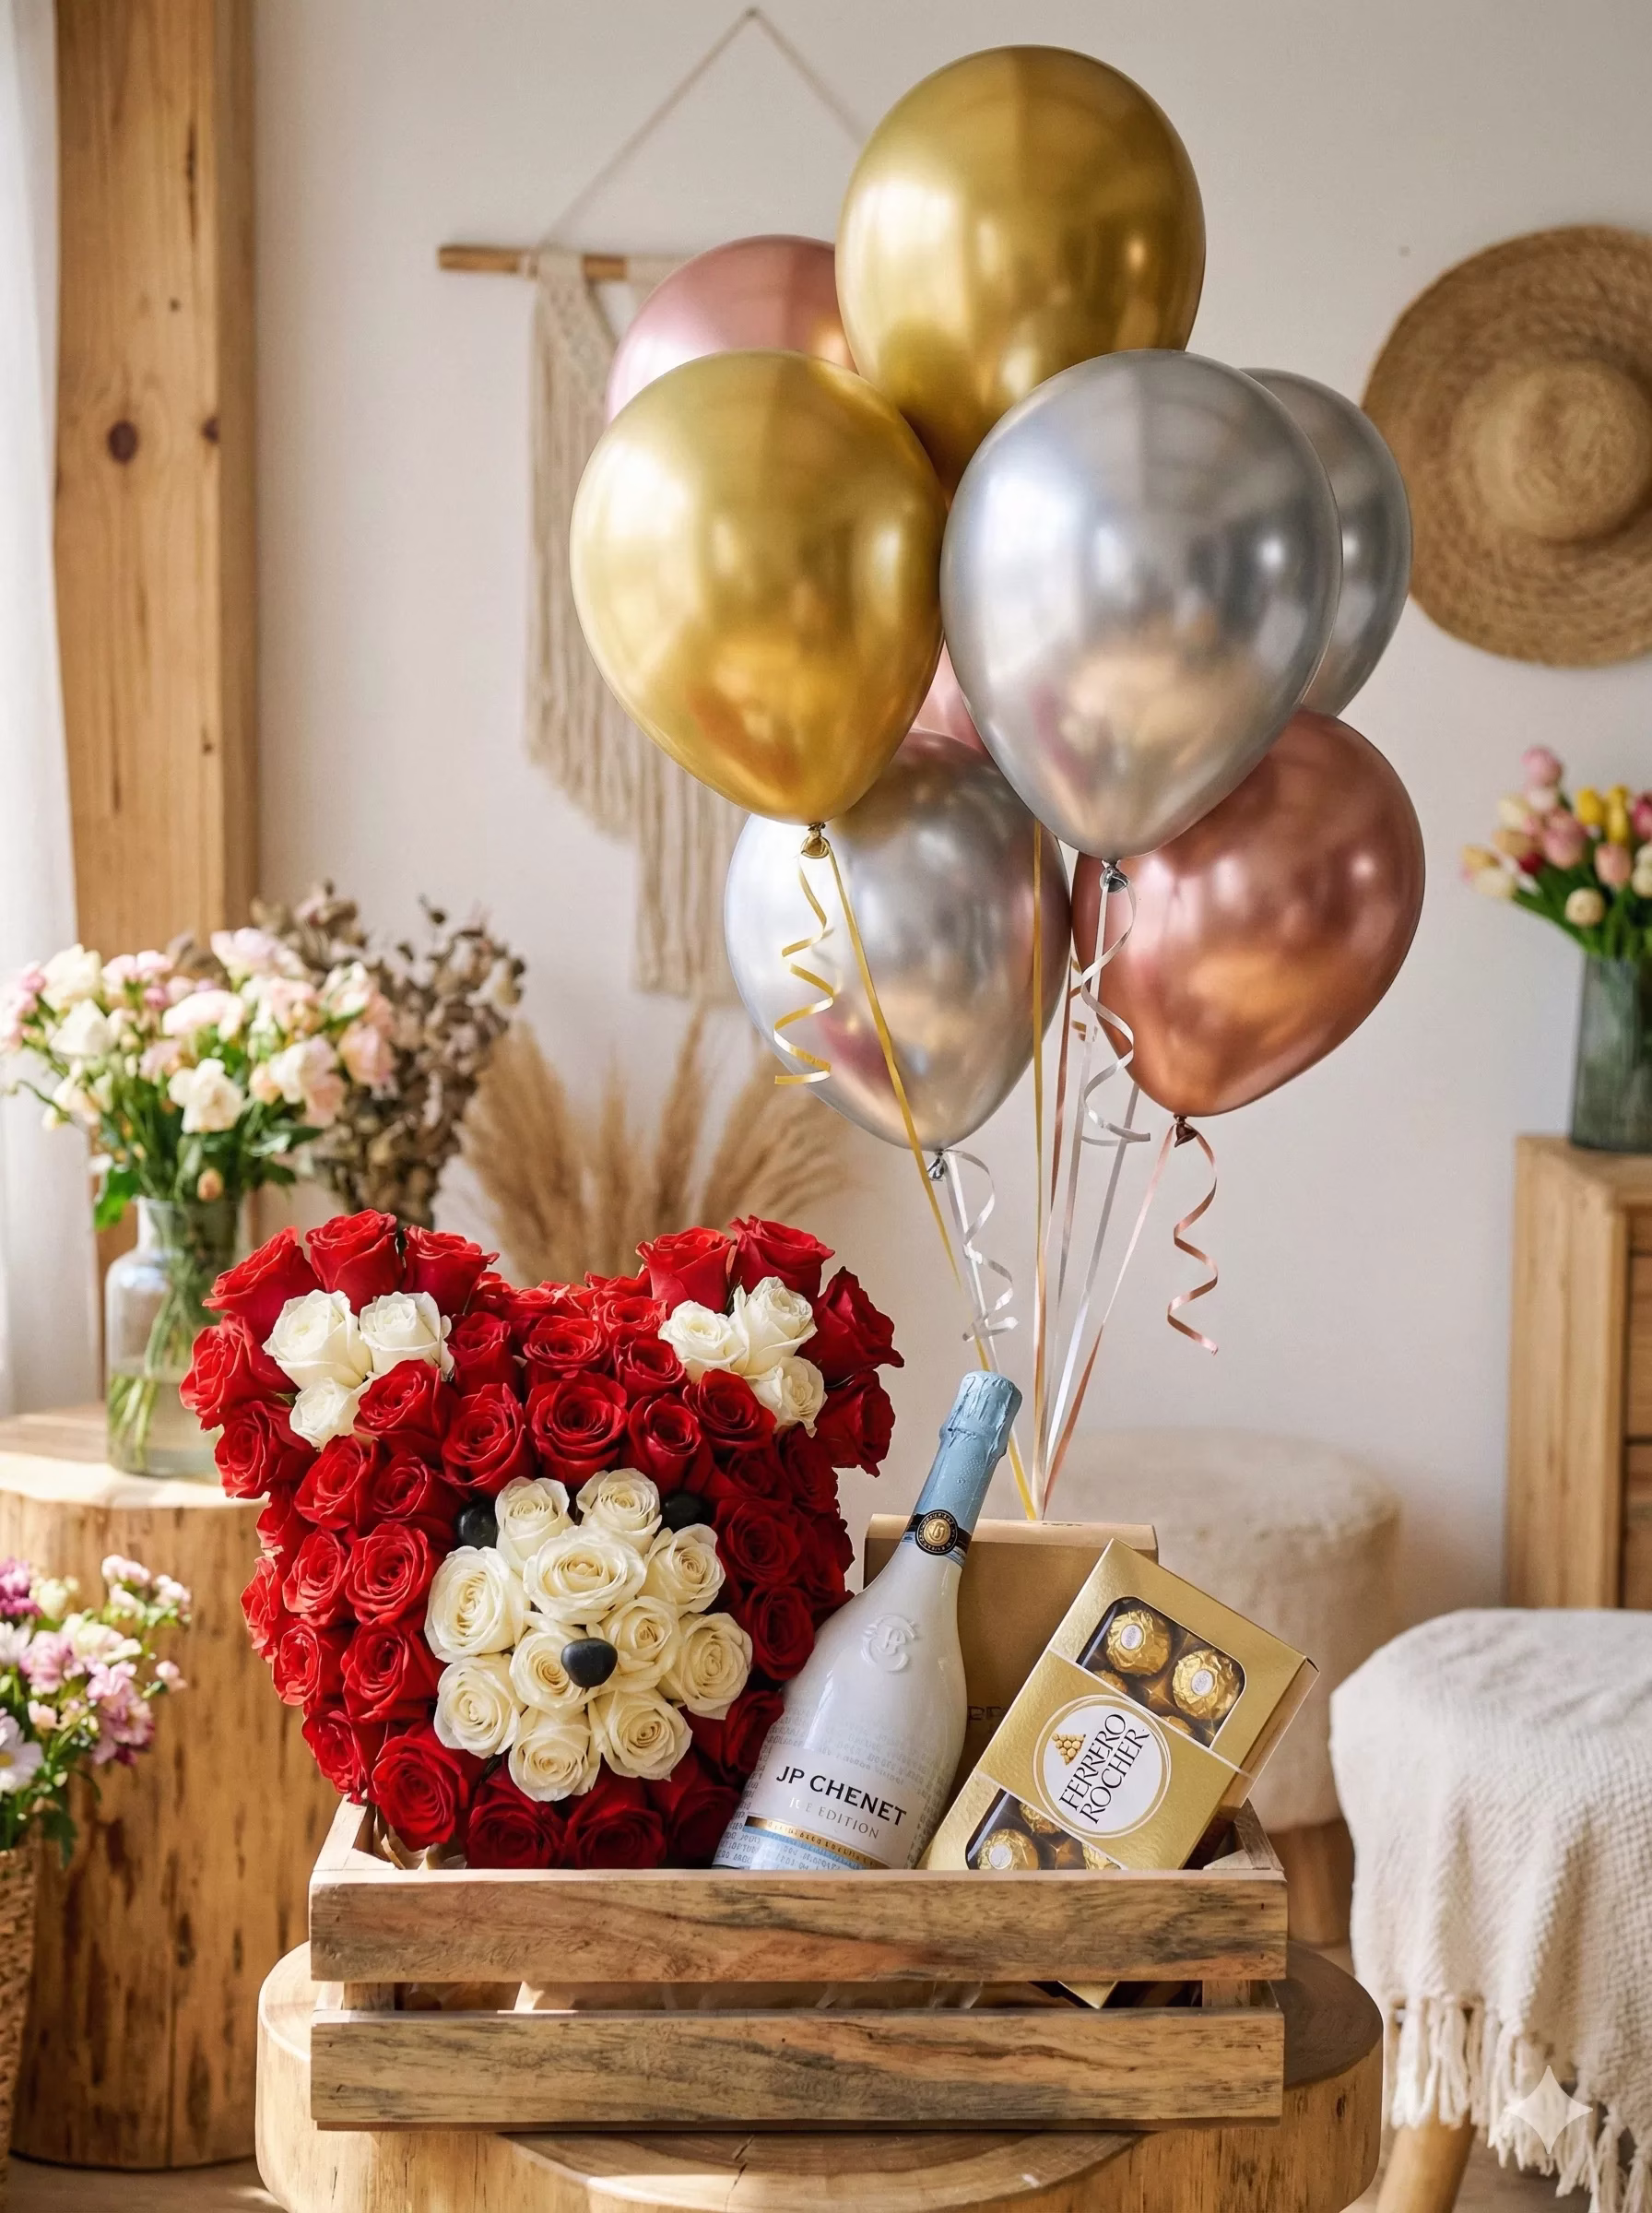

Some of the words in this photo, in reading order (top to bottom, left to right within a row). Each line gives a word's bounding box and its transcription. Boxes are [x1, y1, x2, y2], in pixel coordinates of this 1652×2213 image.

[776, 1766, 805, 1784] JP
[809, 1775, 907, 1826] CHENET
[1058, 1713, 1126, 1811] FERRERO
[1080, 1728, 1150, 1824] ROCHER
[818, 1805, 879, 1840] EDITION
